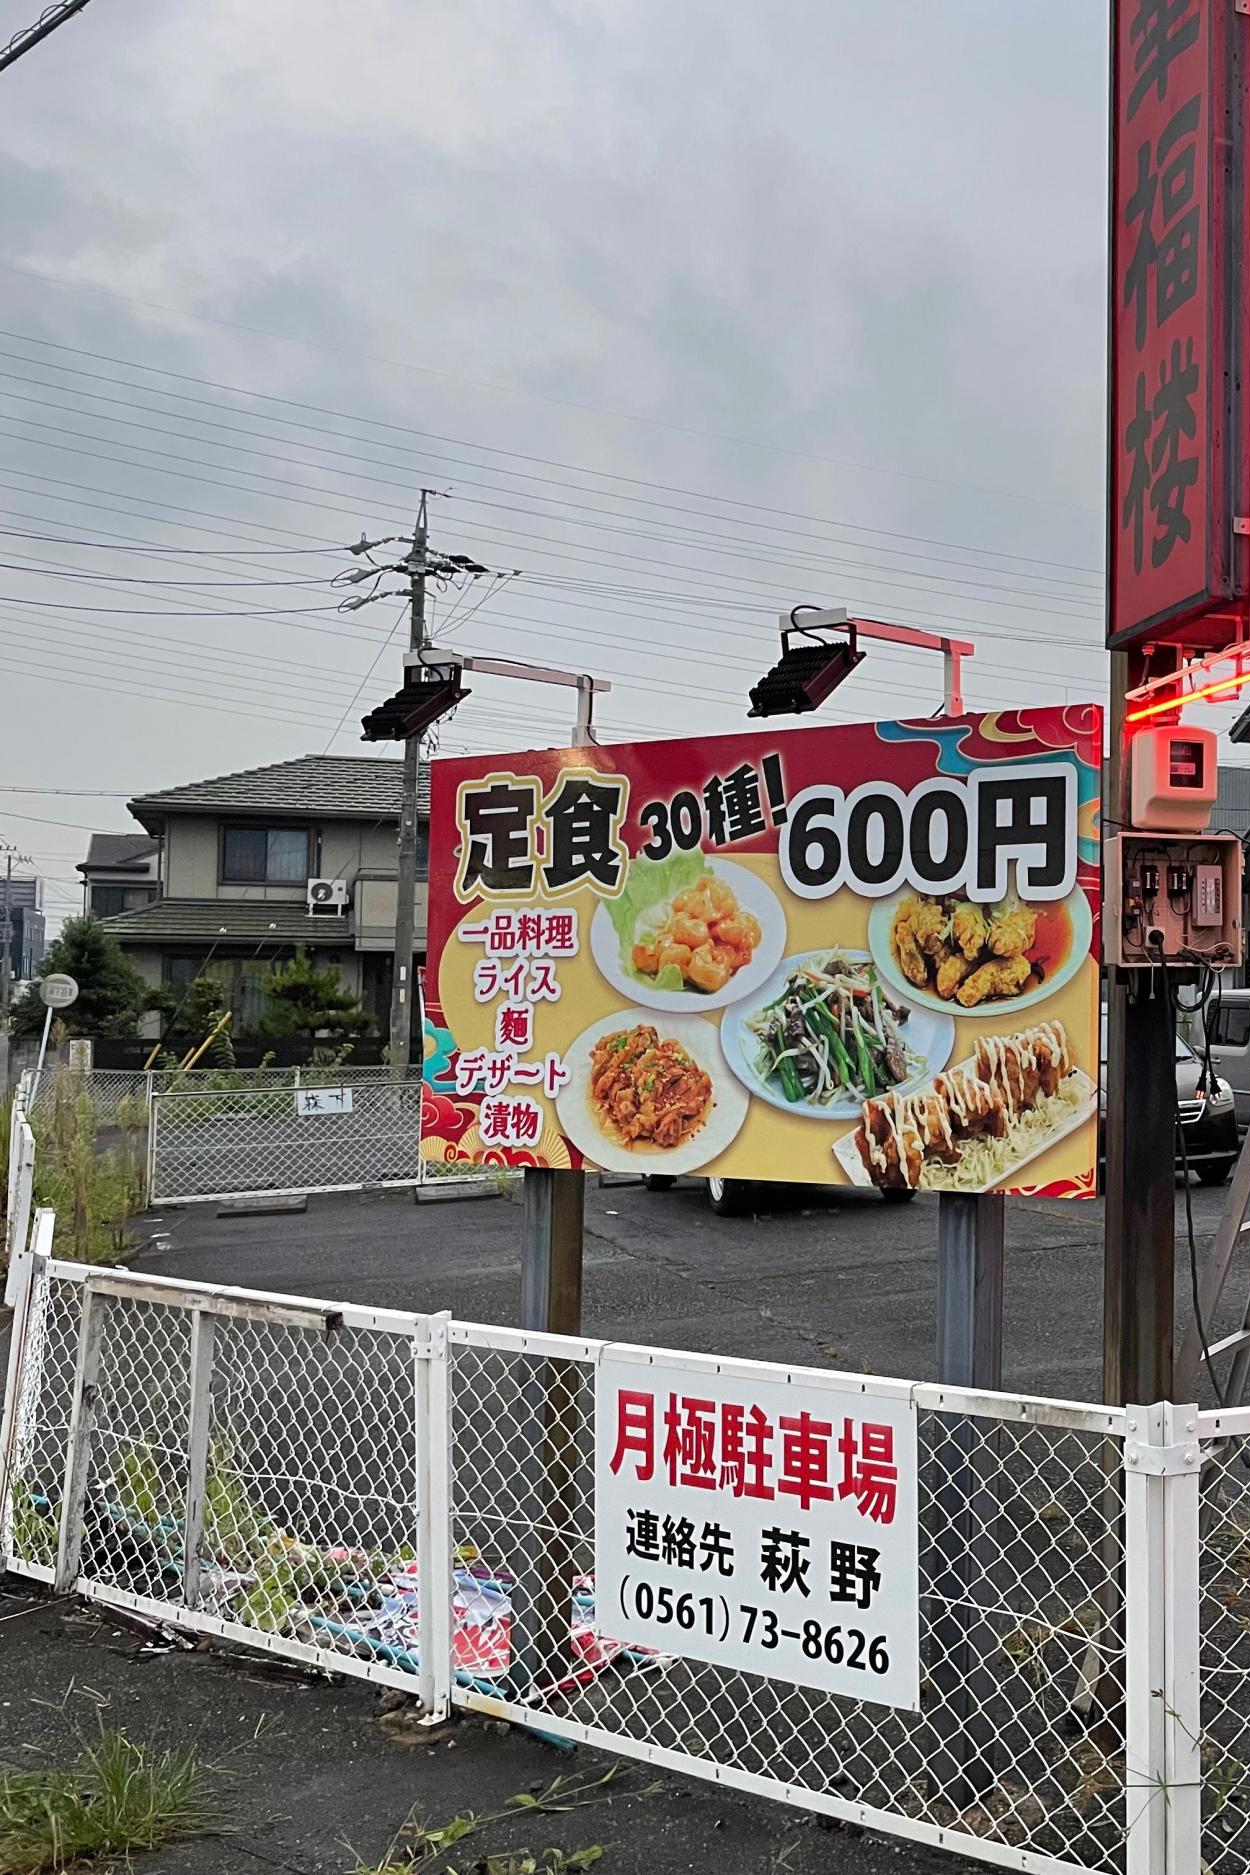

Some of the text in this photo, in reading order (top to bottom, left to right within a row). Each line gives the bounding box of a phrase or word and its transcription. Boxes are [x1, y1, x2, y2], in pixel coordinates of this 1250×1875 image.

[461, 779, 621, 892] 定食
[787, 775, 1067, 892] 600円
[462, 914, 574, 950] 一品料理
[478, 964, 557, 996] ライス
[459, 1053, 566, 1090] デザート
[483, 1101, 539, 1140] 漬物
[609, 1389, 898, 1525] 月極駐車場
[625, 1508, 735, 1577] 連絡先
